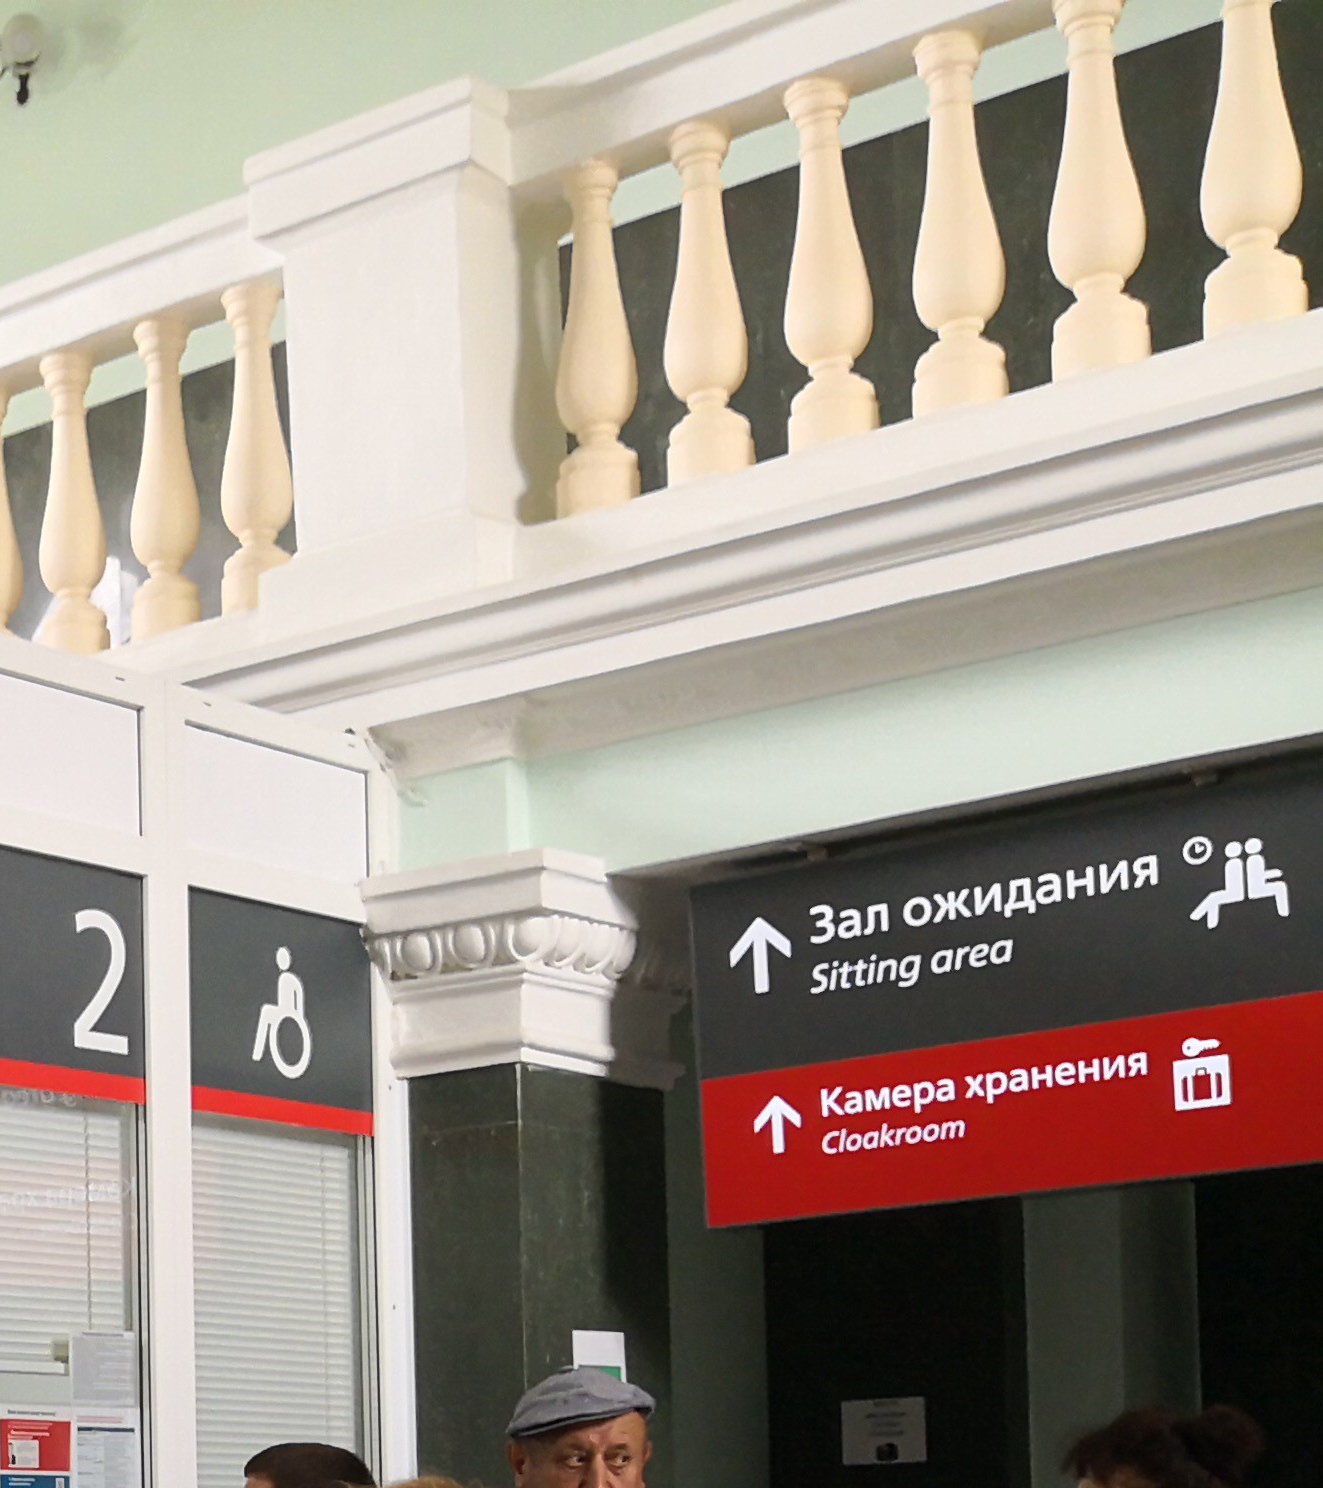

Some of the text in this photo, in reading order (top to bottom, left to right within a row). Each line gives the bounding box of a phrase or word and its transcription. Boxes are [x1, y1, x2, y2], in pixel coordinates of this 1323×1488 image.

[809, 854, 1159, 944] Зал ожидания
[74, 909, 130, 1056] 2
[810, 937, 1014, 994] Sitting area
[819, 1050, 1149, 1118] Камера хранения
[821, 1117, 966, 1156] Cloakroom
